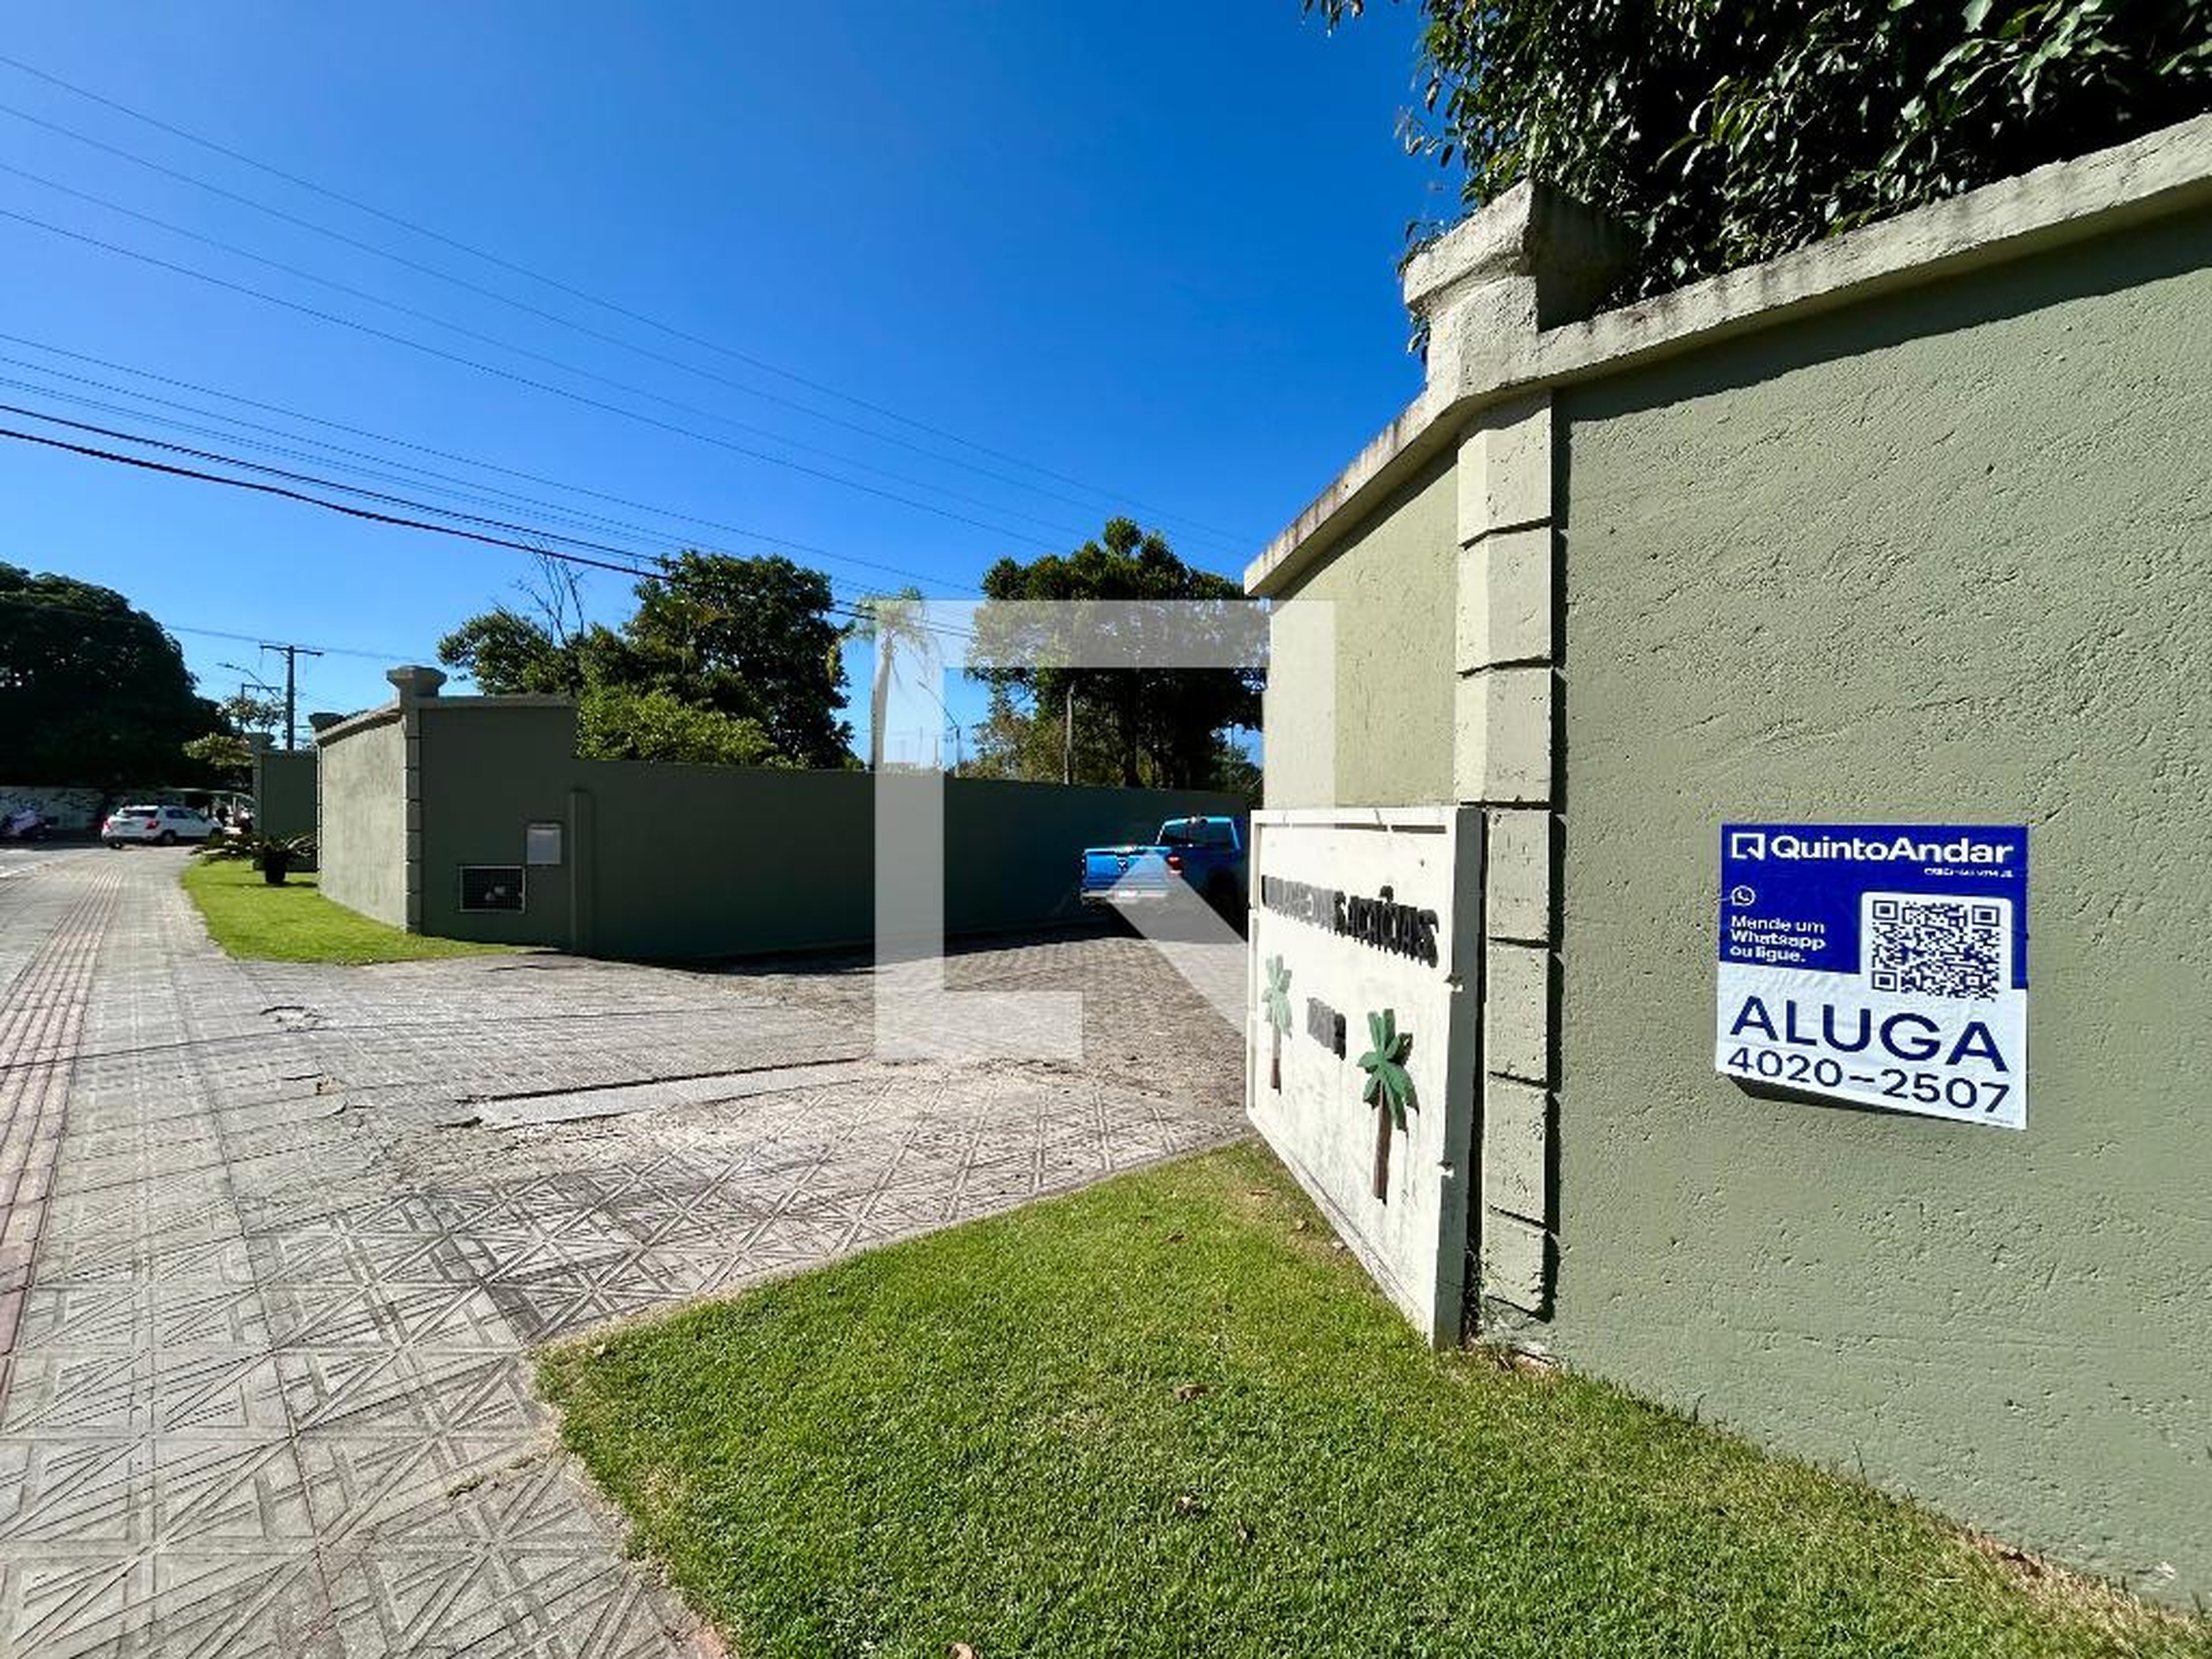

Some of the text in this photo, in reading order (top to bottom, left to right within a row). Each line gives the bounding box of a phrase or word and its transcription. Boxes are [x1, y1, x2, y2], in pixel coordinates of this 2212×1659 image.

[1770, 835, 2014, 863] QuintoAndar
[1731, 915, 1825, 934] Mande um
[1730, 929, 1826, 950] Whatsapp
[1730, 946, 1806, 963] ou ligue.
[1729, 995, 2009, 1073] ALUGA
[1728, 1046, 2010, 1113] 4020-2507
